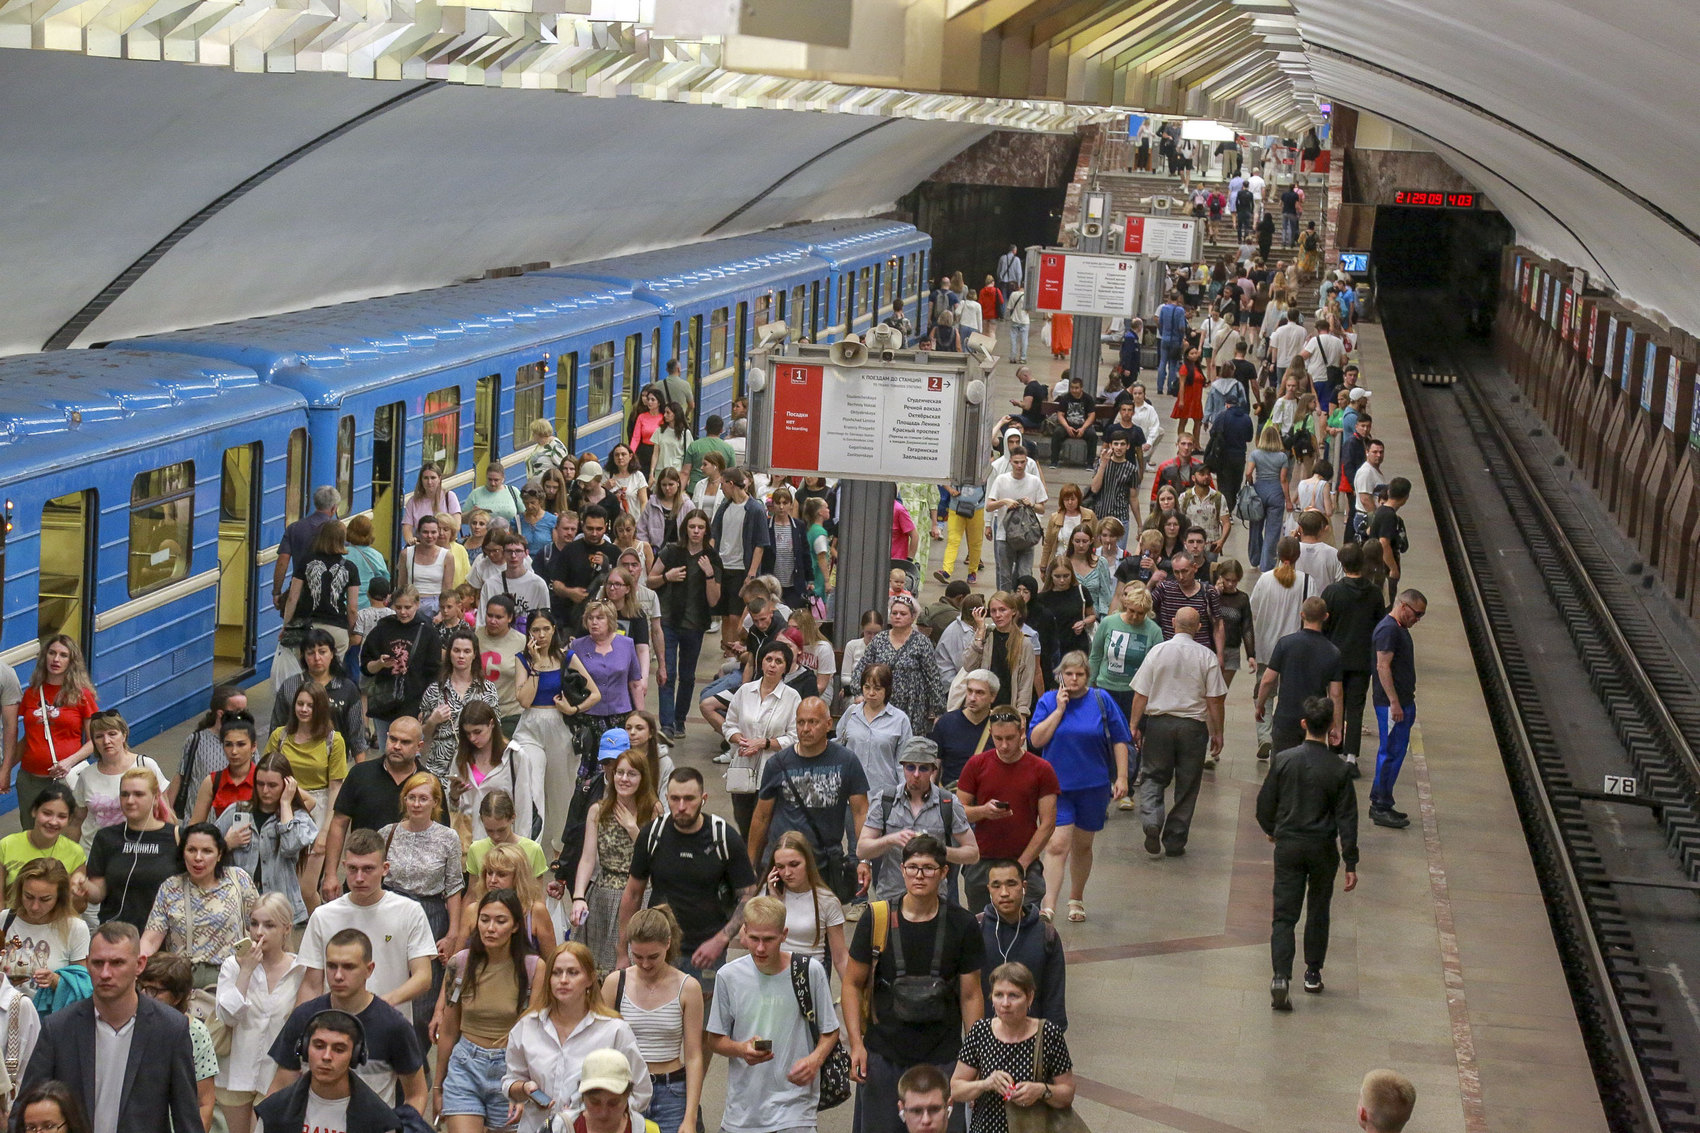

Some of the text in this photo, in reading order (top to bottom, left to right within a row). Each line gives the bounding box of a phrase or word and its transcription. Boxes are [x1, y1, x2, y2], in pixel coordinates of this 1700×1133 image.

[796, 370, 802, 380] 1
[932, 378, 938, 388] 2
[786, 410, 809, 418] Посадки
[907, 412, 941, 420] Октябрьская
[896, 419, 920, 427] Площадь
[907, 446, 939, 454] Гагаринская
[902, 453, 938, 461] Заельцовская
[1607, 777, 1634, 793] 78
[122, 841, 160, 855] ДУШНИЛА
